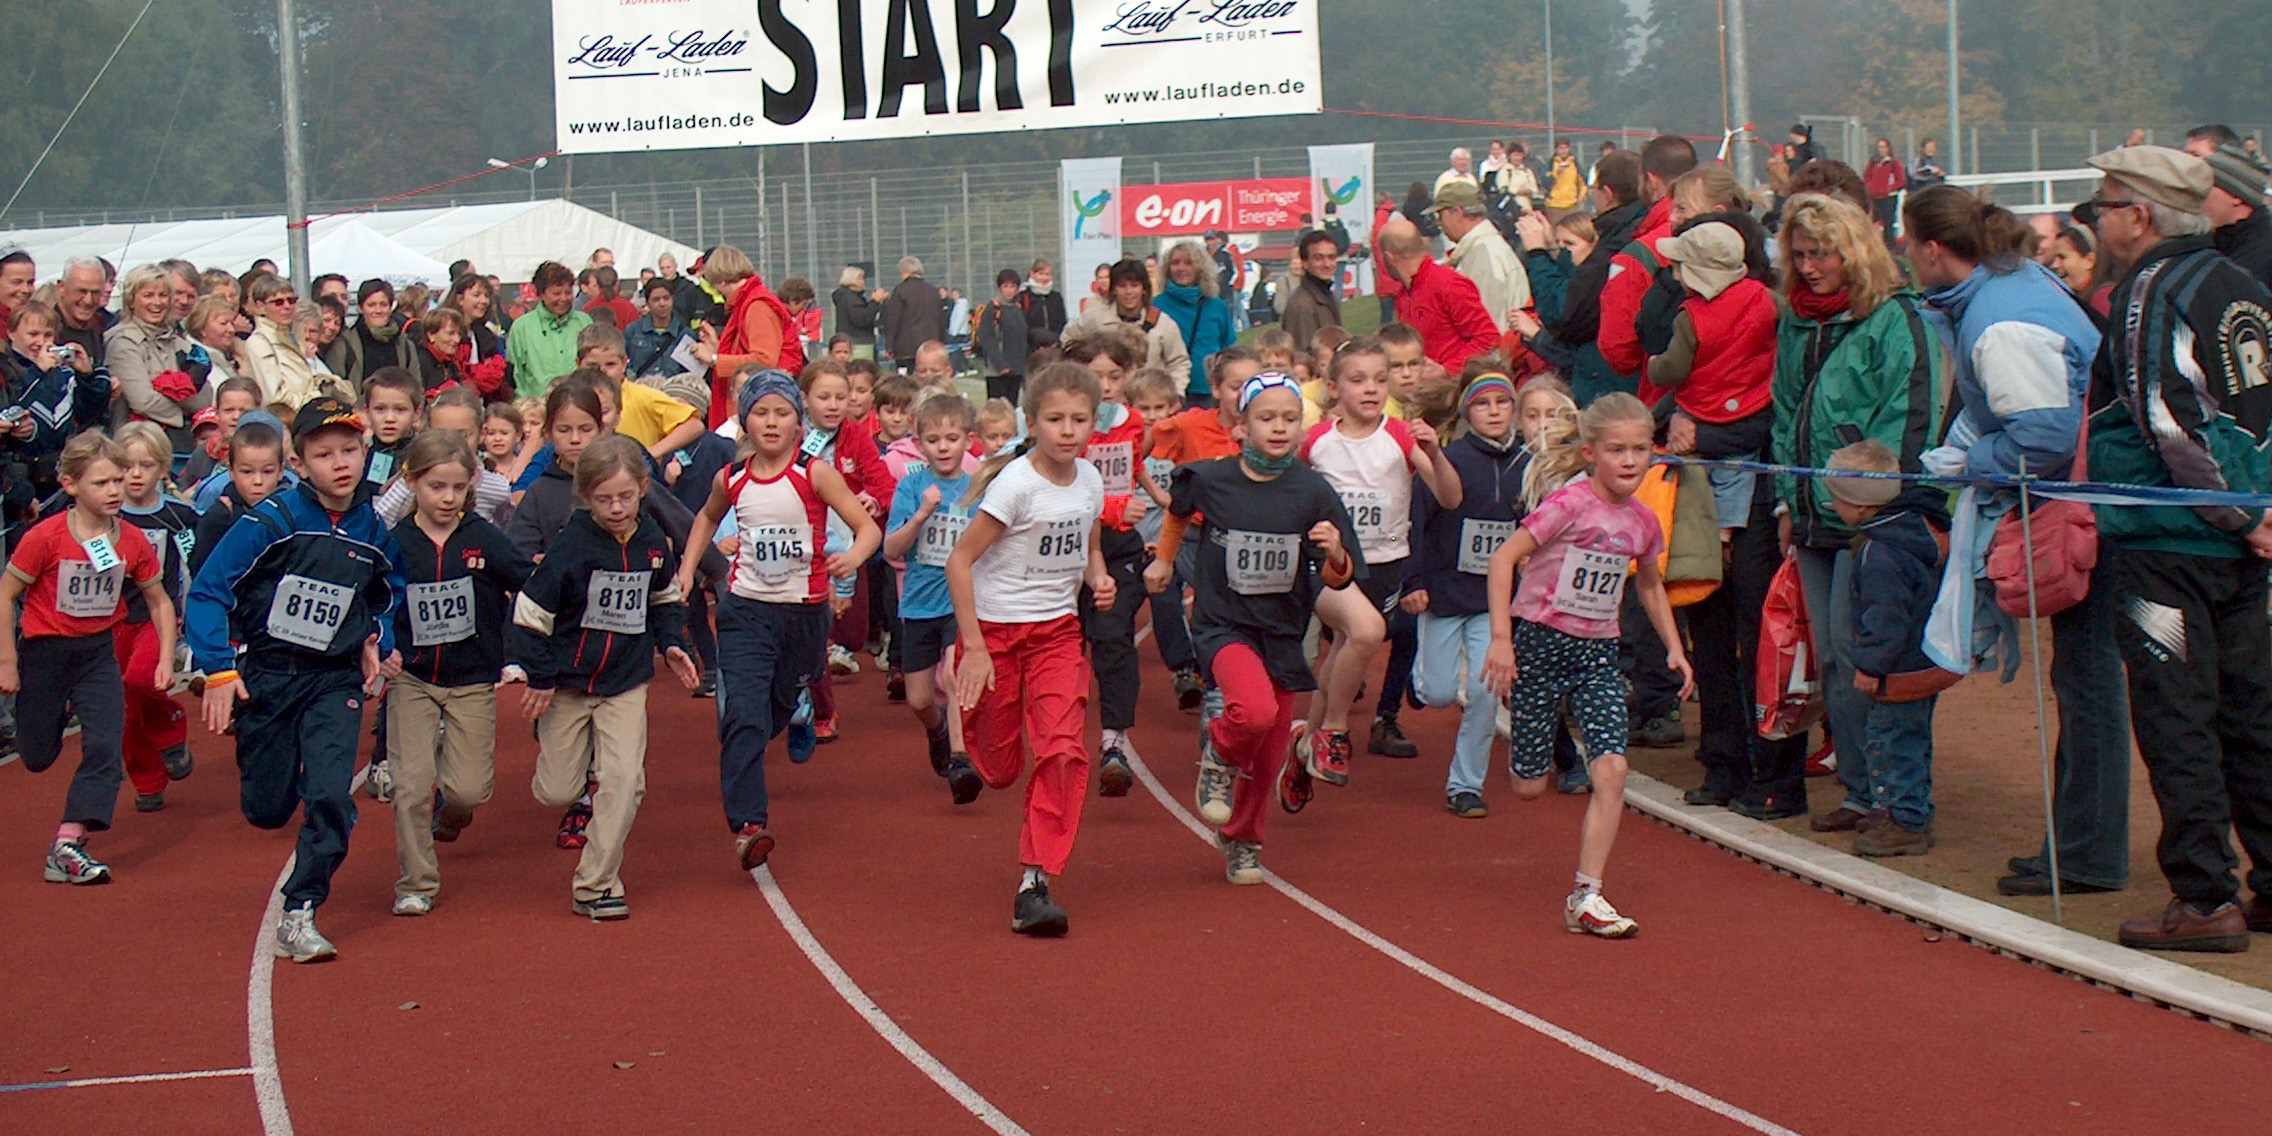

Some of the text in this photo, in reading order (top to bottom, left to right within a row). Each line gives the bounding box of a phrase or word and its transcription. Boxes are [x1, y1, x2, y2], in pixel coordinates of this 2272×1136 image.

[1204, 29, 1268, 43] ERFURT
[663, 67, 702, 79] JENA
[1104, 78, 1306, 105] www.laufladen.de
[569, 112, 755, 134] www.laufladen.de
[1237, 189, 1301, 206] Thüringer
[1238, 208, 1289, 226] Energie
[1094, 457, 1128, 477] 8105
[1346, 505, 1382, 526] 126
[760, 527, 798, 535] TEAG
[927, 526, 963, 547] 811
[90, 539, 114, 567] 8114
[756, 540, 804, 561] 8145
[1039, 531, 1082, 557] 8154
[1472, 535, 1505, 555] 812
[1237, 549, 1289, 571] 8109
[69, 576, 115, 596] 8114
[1572, 567, 1622, 595] 8127
[285, 594, 341, 628] 8159
[418, 595, 468, 623] 8129
